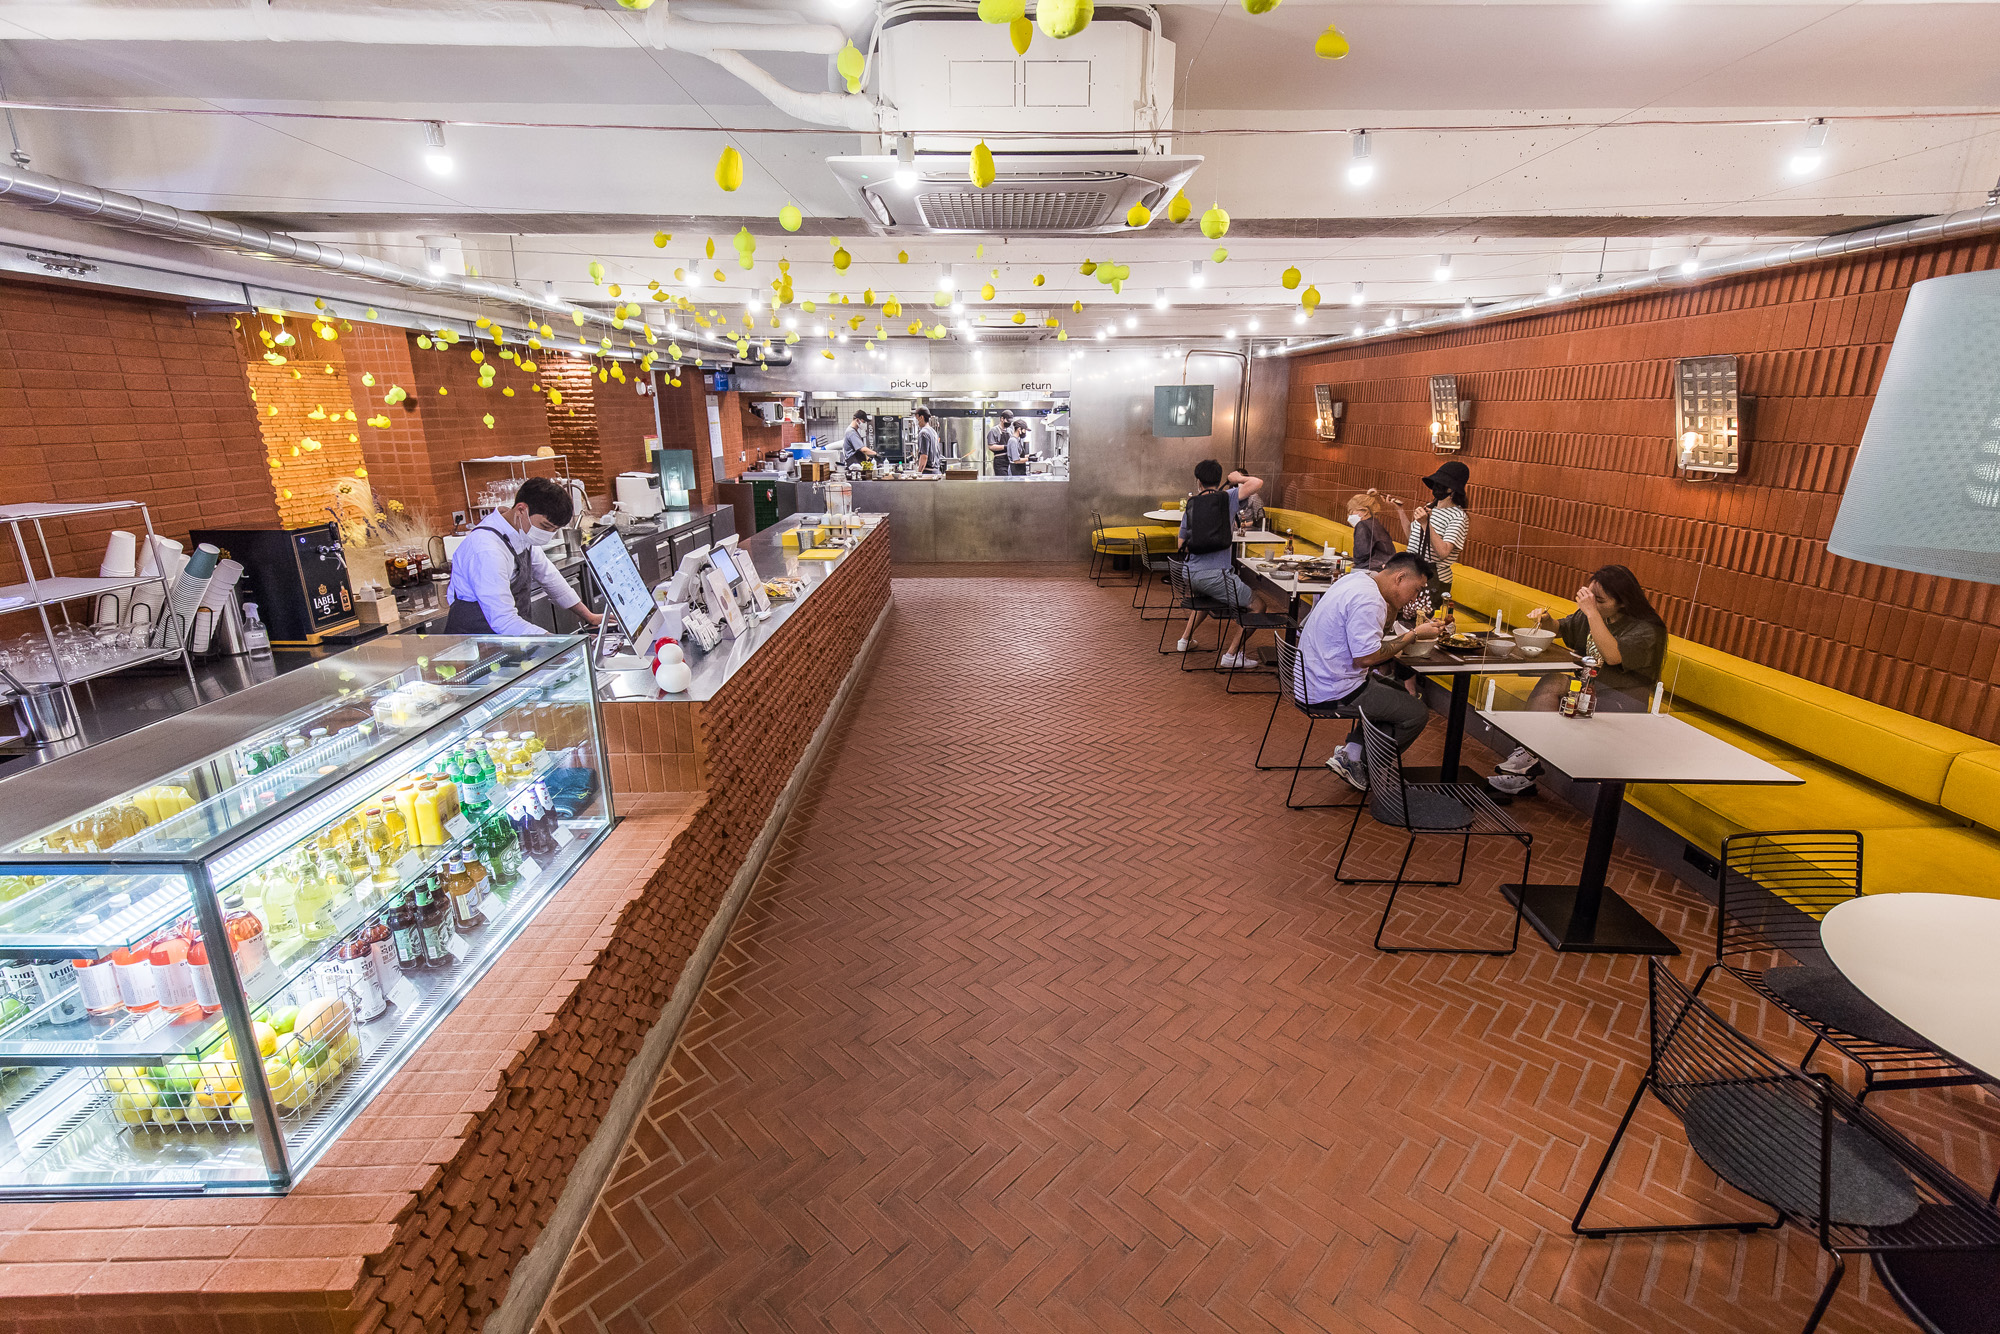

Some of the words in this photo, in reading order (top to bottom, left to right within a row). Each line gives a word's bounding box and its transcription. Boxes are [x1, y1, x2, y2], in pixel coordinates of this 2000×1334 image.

[890, 379, 929, 389] pick-up
[1021, 382, 1052, 390] return
[313, 593, 338, 609] LABEL
[323, 604, 331, 615] 5
